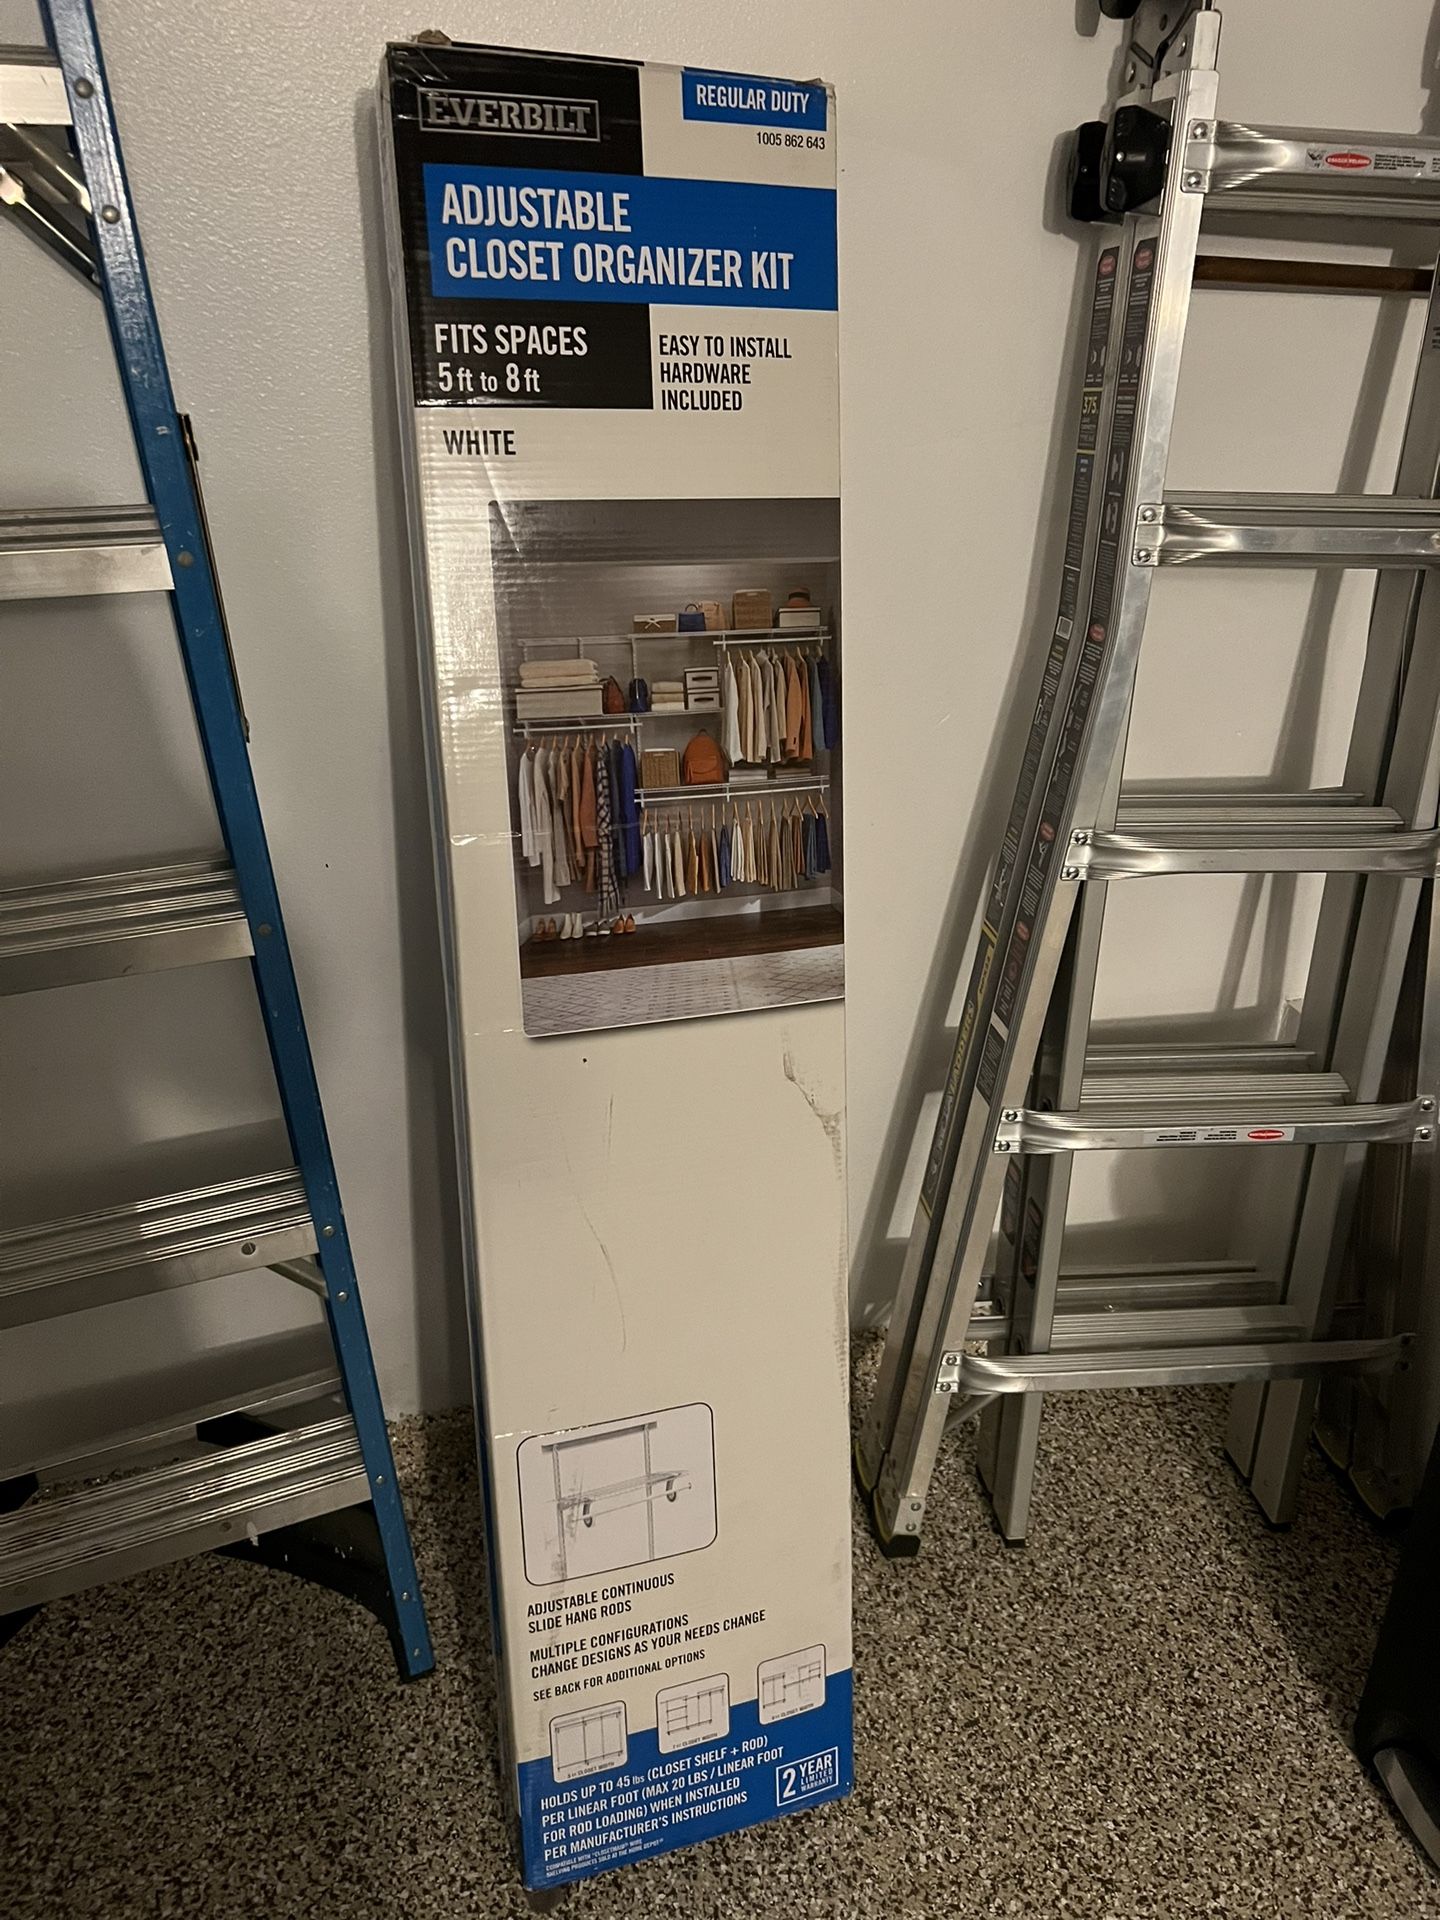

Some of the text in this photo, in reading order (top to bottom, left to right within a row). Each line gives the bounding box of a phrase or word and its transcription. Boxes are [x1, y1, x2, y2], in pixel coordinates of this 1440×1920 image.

[426, 95, 591, 134] EVERBILT
[696, 84, 809, 114] REGULAR DUTY
[756, 132, 826, 150] 1005 862 643
[442, 183, 632, 232] ADJUSTABLE
[446, 237, 794, 290] CLOSET ORGANIZER KIT
[434, 323, 588, 356] FITS SPACES
[659, 335, 792, 359] EASY TO INSTALL
[438, 362, 540, 393] 5 ft to 8 ft
[660, 362, 751, 384] HARDWARE
[661, 390, 742, 411] INCLUDED
[443, 430, 516, 456] WHITE
[527, 1573, 675, 1617] ADJUSTABLE CONTINUOUS
[528, 1600, 632, 1634] SLIDE HANG RODS
[530, 1614, 688, 1662] MULTIPLE CONFIGURATIONS
[531, 1609, 766, 1679] CHANGE DESIGNS AS YOUR NEEDS CHANGE
[533, 1649, 705, 1701] SEE BACK FOR ADDITIONAL OPTIONS
[541, 1735, 768, 1811] HOLDS UP TO 45 lbs (CLOSET SHELF + ROD)
[799, 1754, 833, 1777] YEAR
[801, 1768, 833, 1785] LIMITED
[542, 1746, 784, 1827] PER LINEAR FOOT (MAX 20 LBS / LINEAR FOOT
[782, 1767, 796, 1799] 2
[543, 1777, 740, 1844] FOR ROD LOADING) WHEN INSTALLED
[544, 1791, 748, 1862] PER MANUFACTURER'S INSTRUCTIONS
